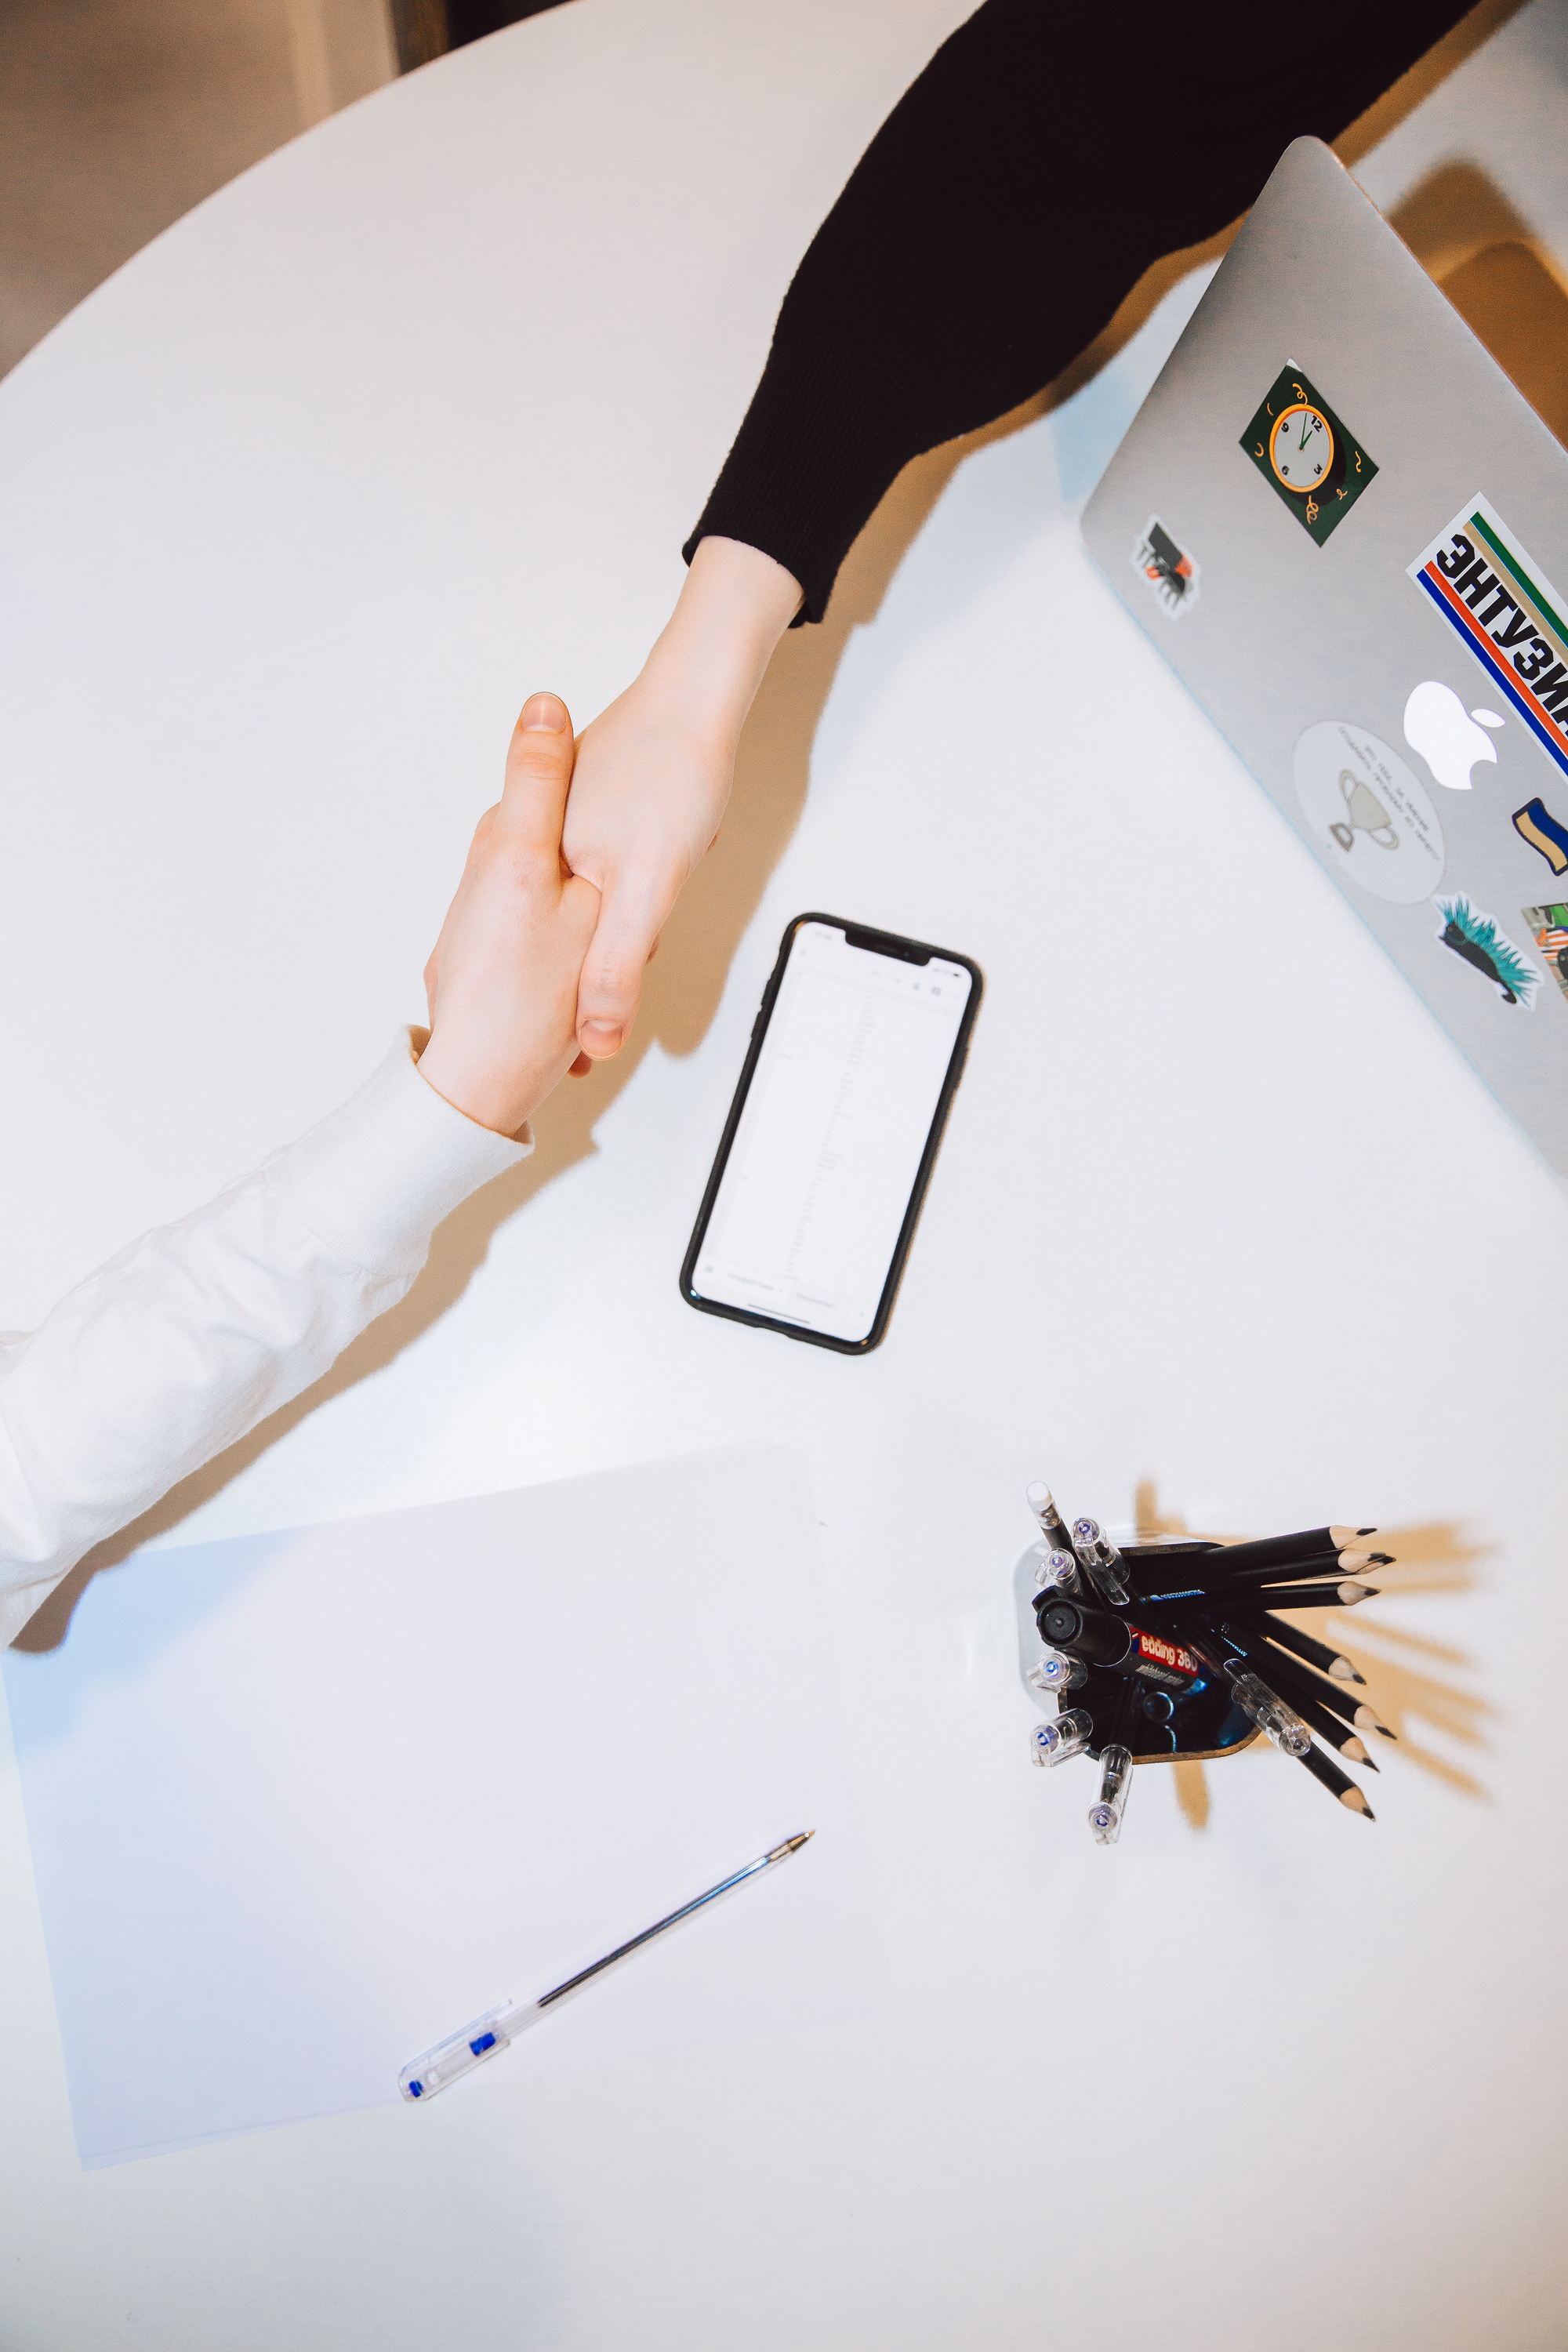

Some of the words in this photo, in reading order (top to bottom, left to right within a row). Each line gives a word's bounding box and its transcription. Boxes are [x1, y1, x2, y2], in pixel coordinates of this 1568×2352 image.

[1281, 423, 1289, 433] 9
[1311, 416, 1323, 433] 12
[1282, 466, 1290, 475] 6
[1314, 463, 1323, 474] 3
[1142, 1635, 1175, 1665] edding
[1177, 1648, 1198, 1671] 360
